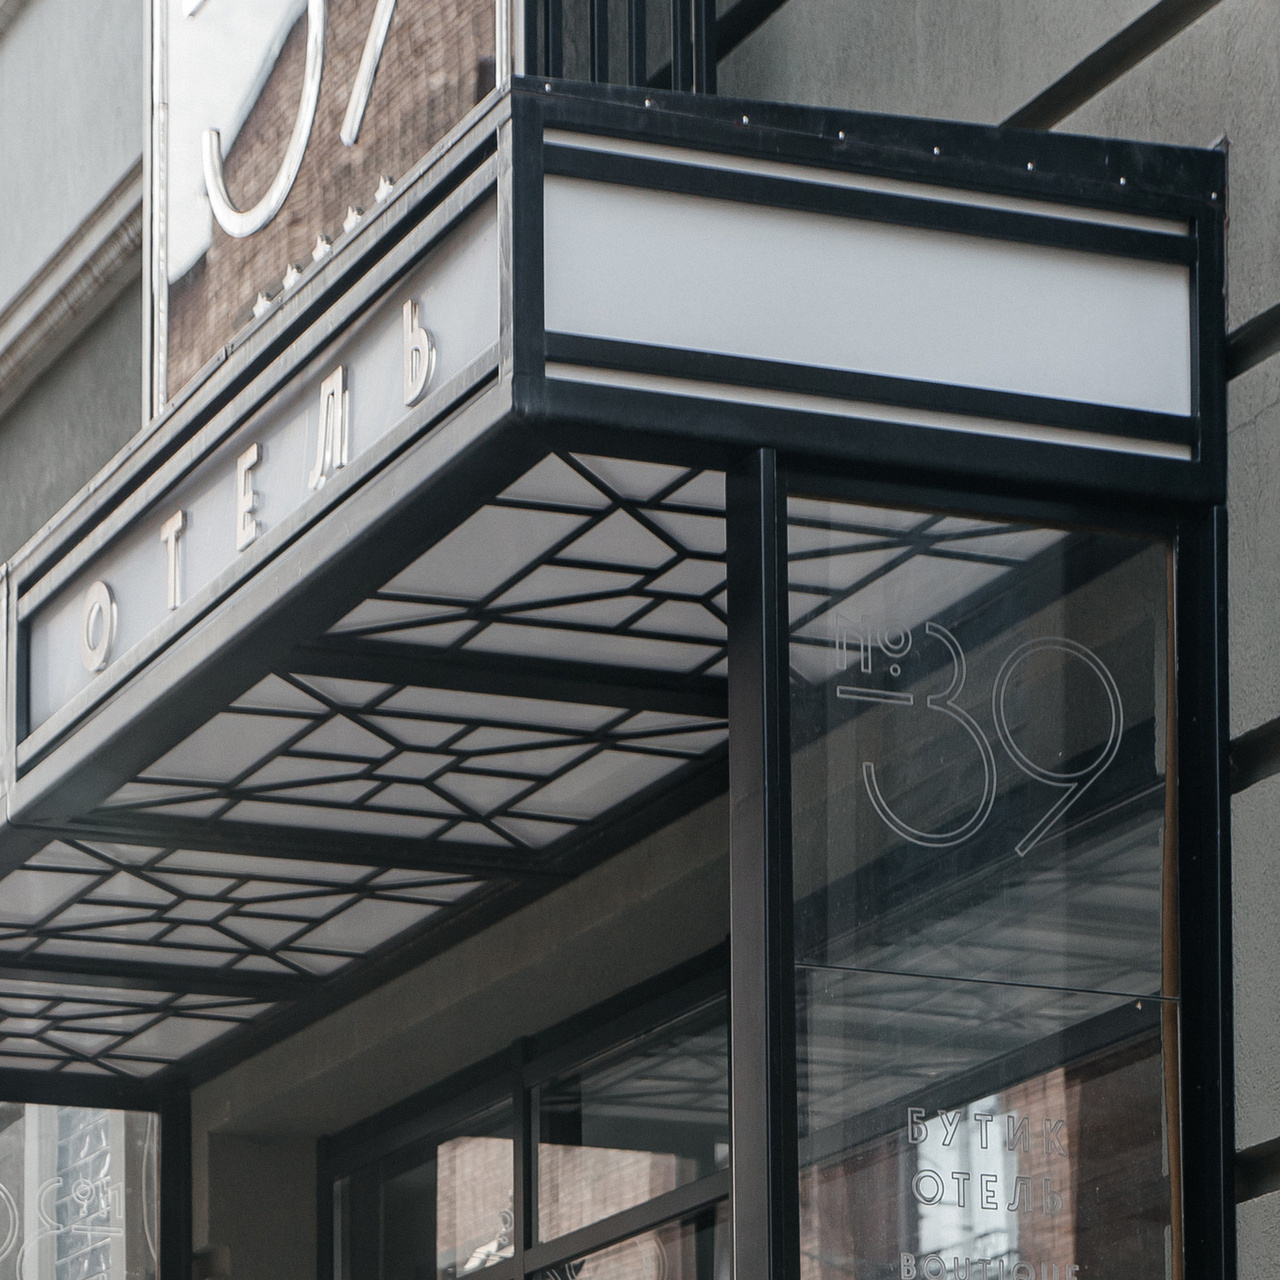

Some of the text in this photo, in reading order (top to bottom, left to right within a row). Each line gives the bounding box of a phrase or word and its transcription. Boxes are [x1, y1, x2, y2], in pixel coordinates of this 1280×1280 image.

[80, 298, 437, 672] ОТЕЛЬ
[907, 1107, 1066, 1156] БУТИК
[911, 1168, 1063, 1216] ОТЕЛЬ
